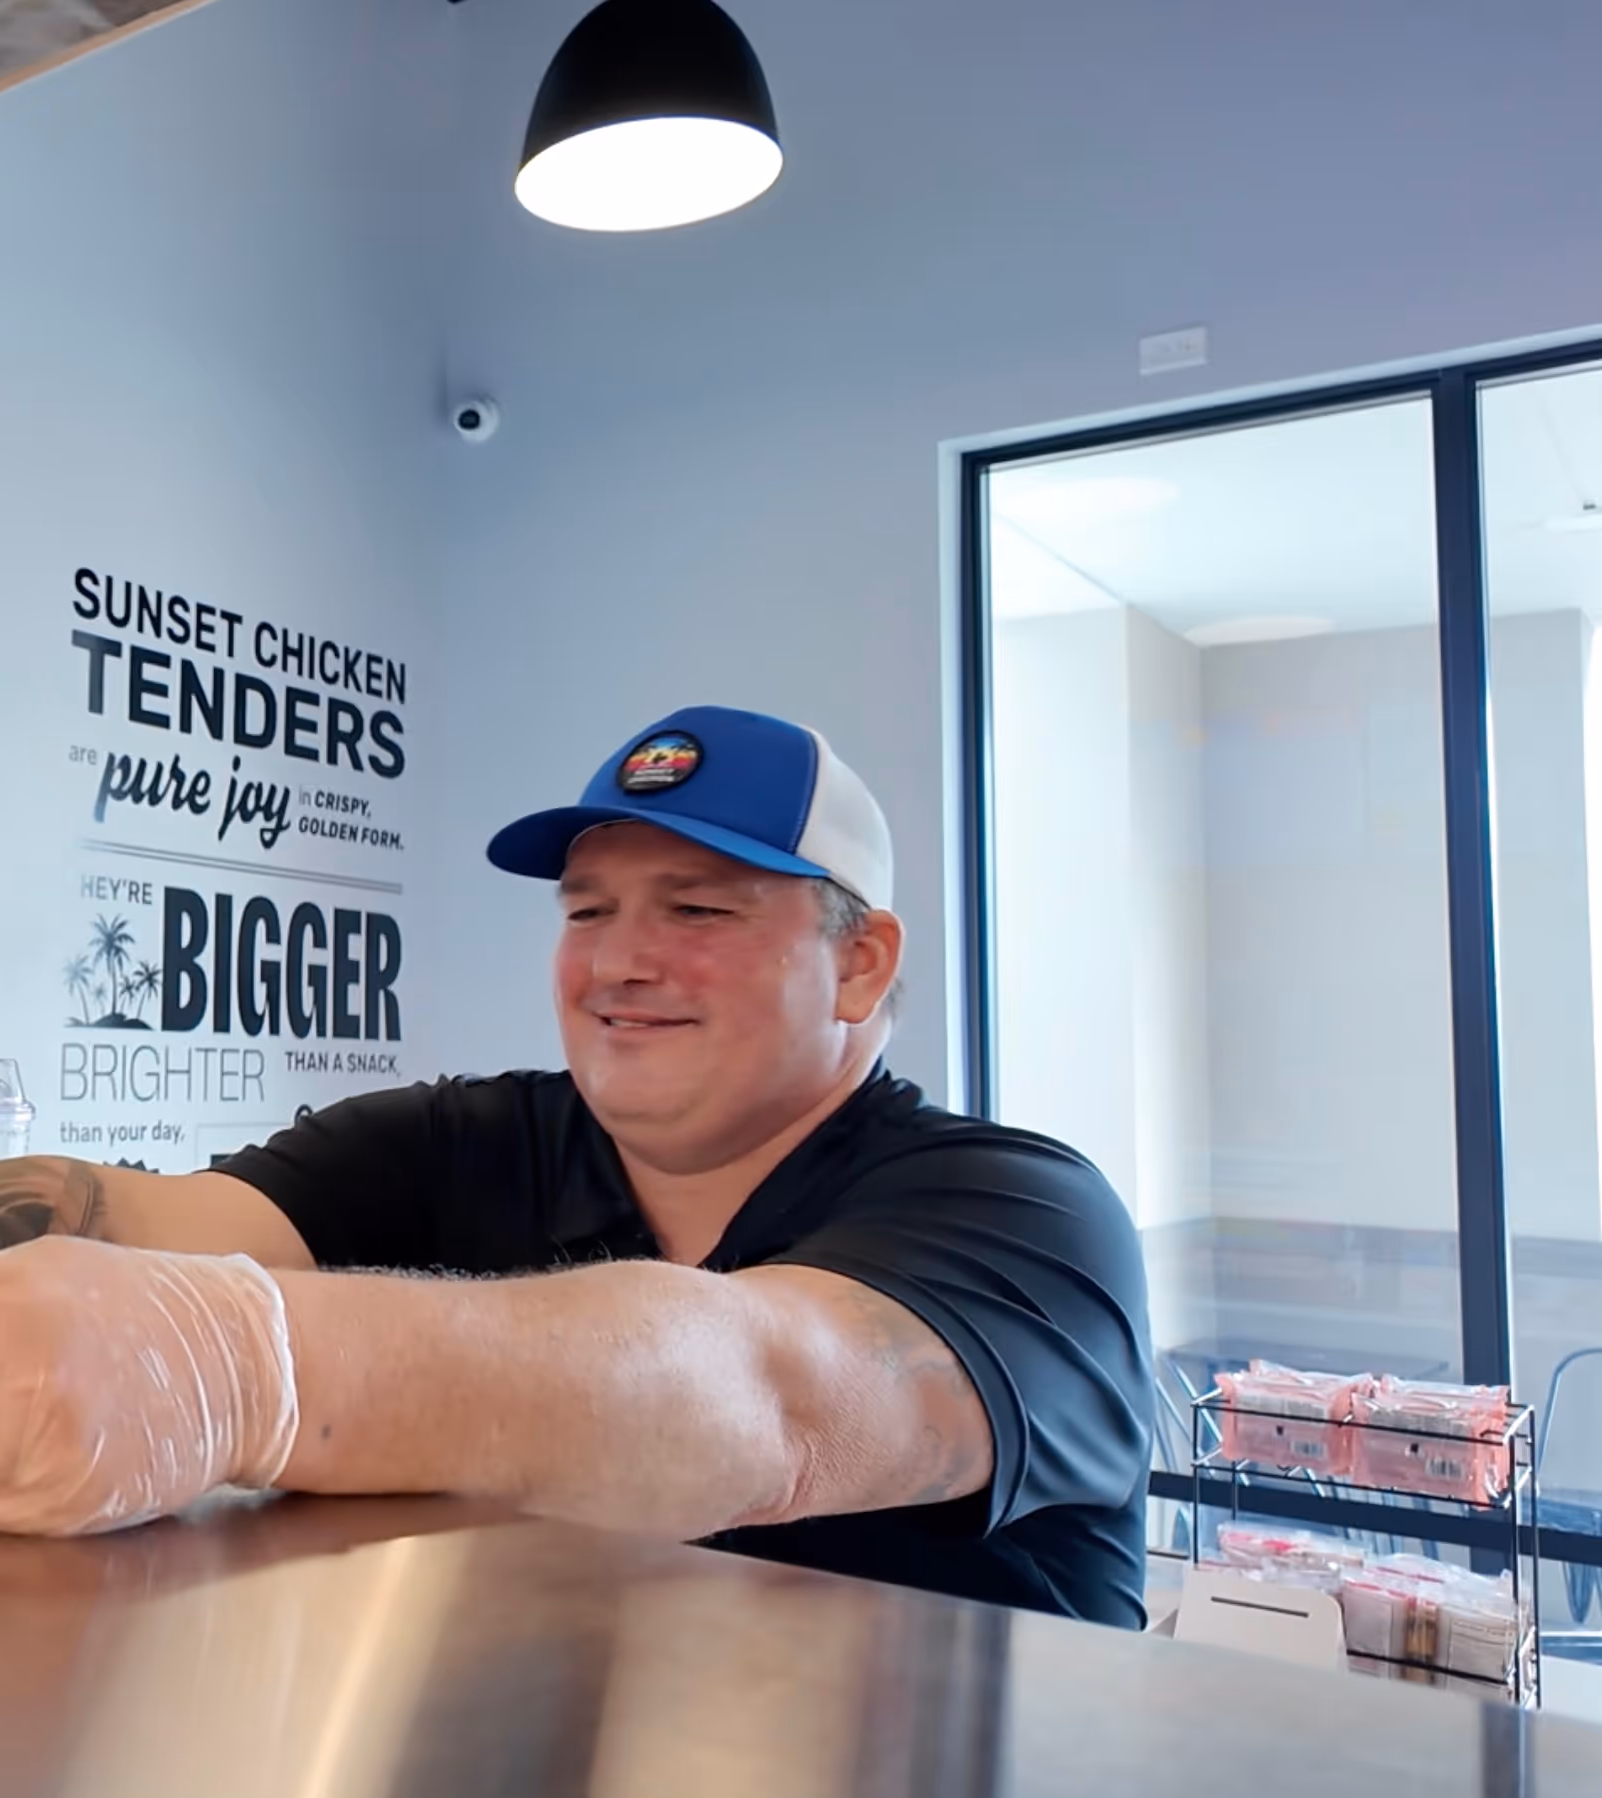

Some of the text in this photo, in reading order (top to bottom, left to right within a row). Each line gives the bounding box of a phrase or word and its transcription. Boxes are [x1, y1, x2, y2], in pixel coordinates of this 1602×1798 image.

[72, 567, 406, 705] SUNSET CHICKEN
[71, 628, 405, 779] TENDERS
[68, 744, 98, 766] are
[93, 752, 211, 824] pure
[218, 755, 291, 850] joy
[298, 816, 359, 843] GOLDEN
[161, 886, 402, 1041] BIGGER
[60, 1042, 265, 1102] BRIGHTER
[285, 1051, 329, 1072] THAN
[333, 1051, 343, 1073] A
[60, 1119, 185, 1148] than your day,
